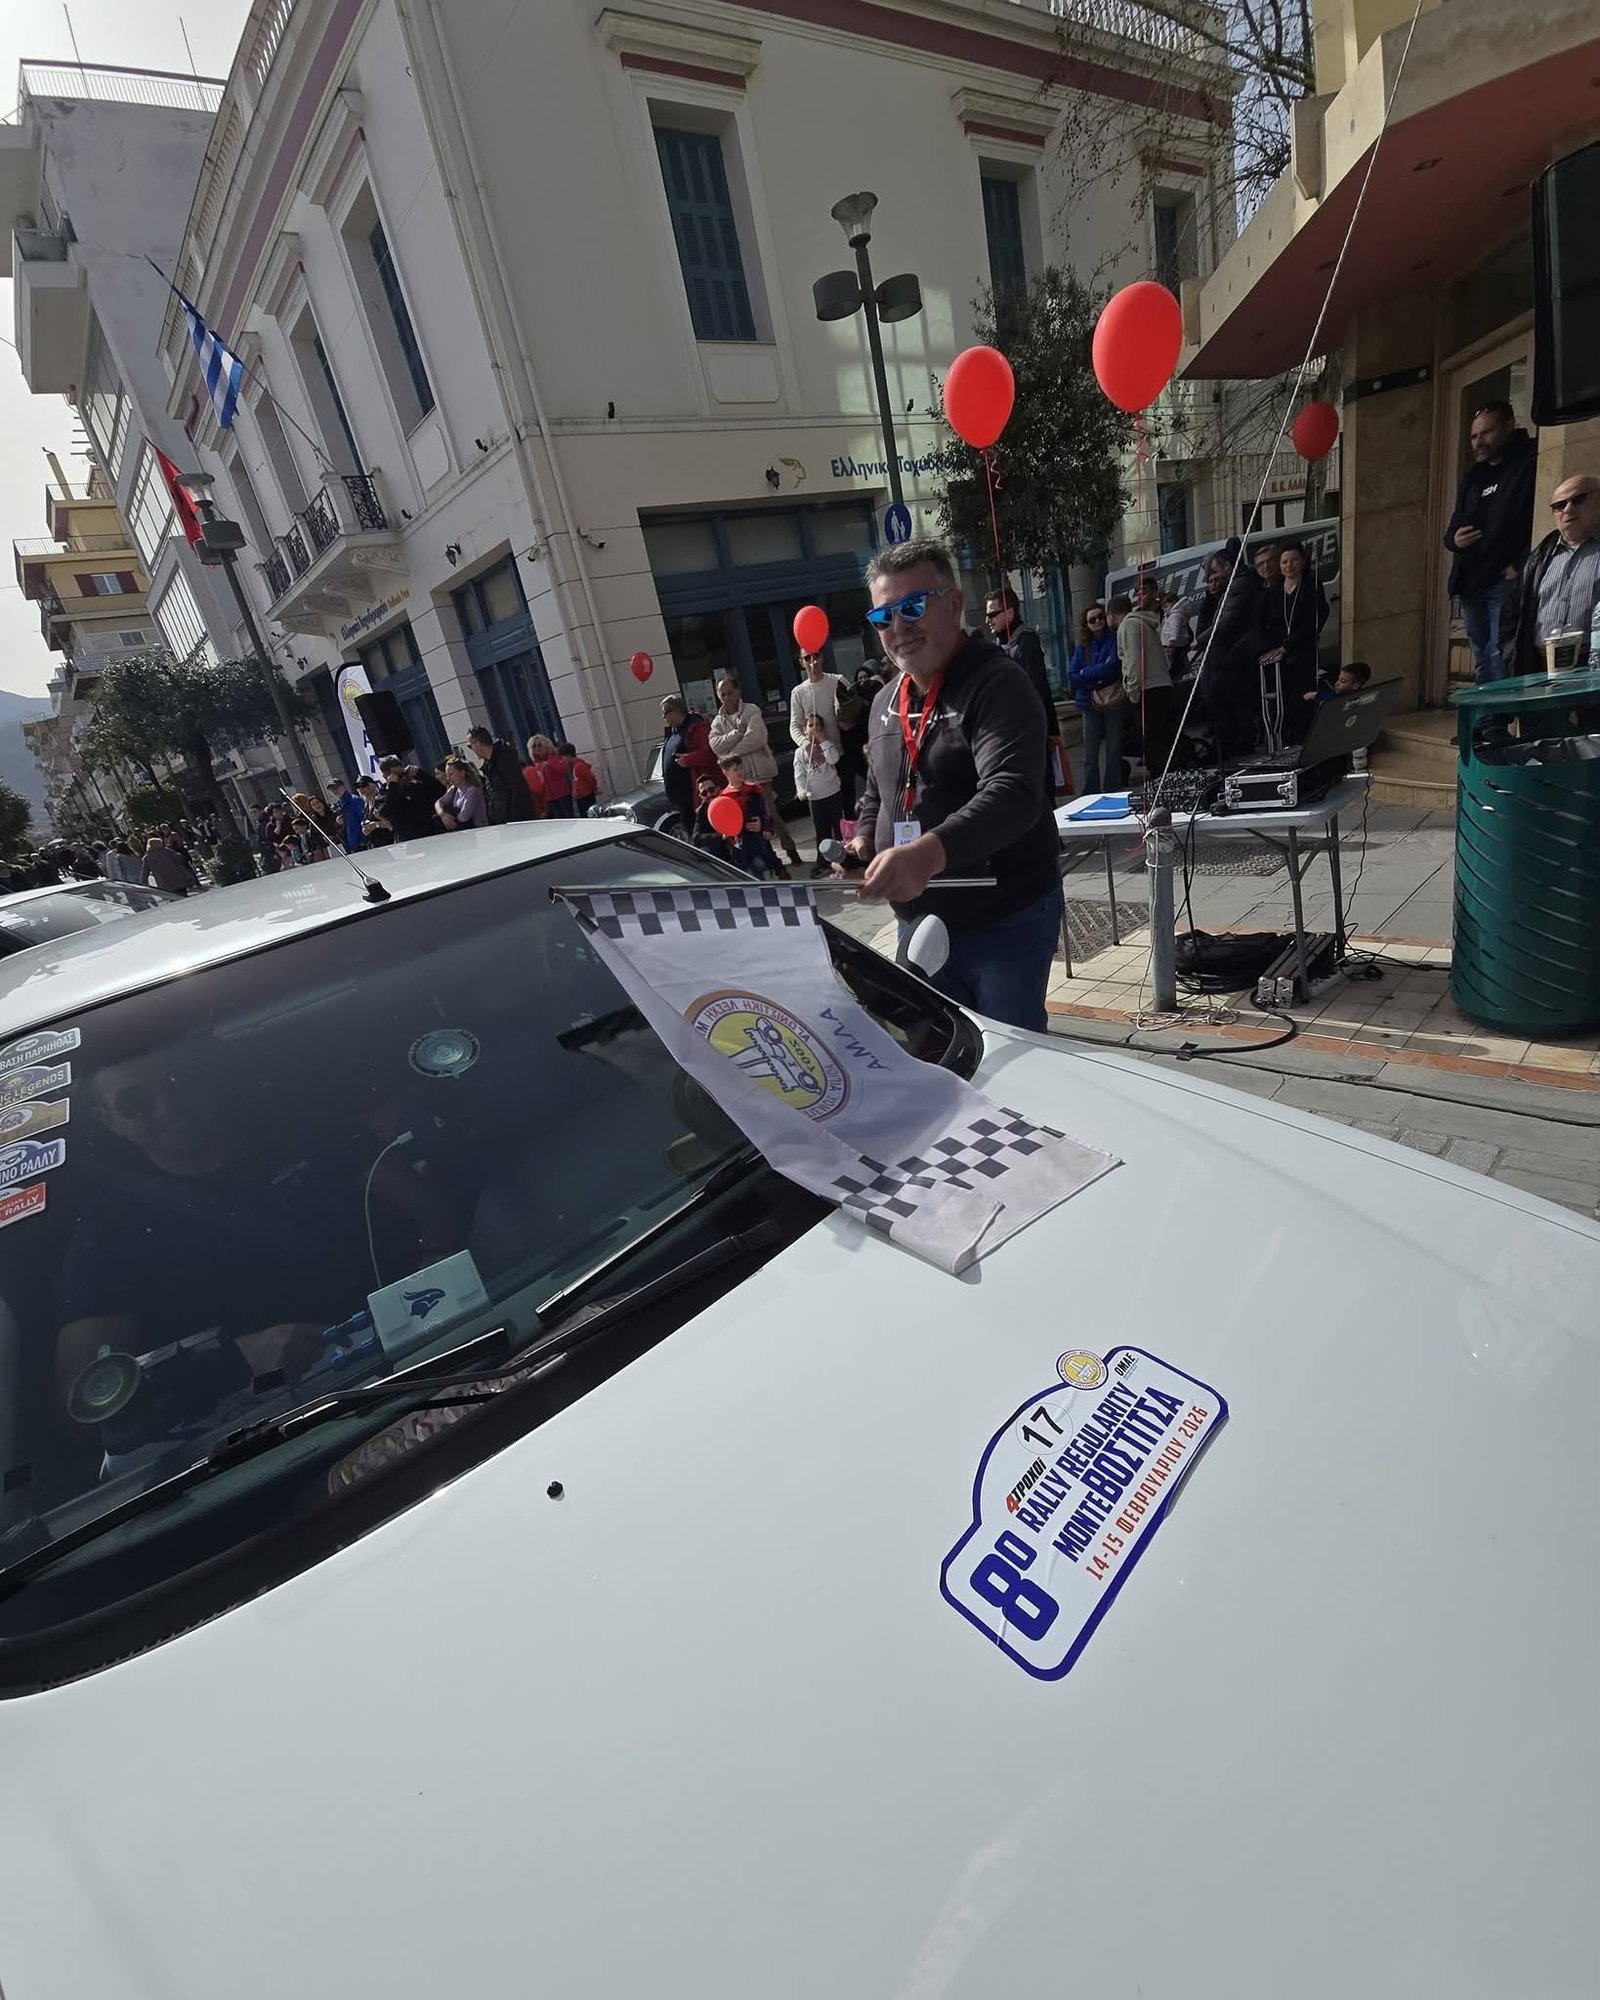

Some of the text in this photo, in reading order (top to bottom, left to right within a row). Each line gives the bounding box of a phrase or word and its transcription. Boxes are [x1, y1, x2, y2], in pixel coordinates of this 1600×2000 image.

[830, 455, 892, 480] Ελληνικ
[0, 1033, 74, 1071] ΒΑΣΗ ΠΑΡΝΗΘΑΣ
[15, 1070, 64, 1096] LEGENDS
[20, 1148, 57, 1175] ΡΑΛΛΥ
[5, 1194, 40, 1216] RALLY
[1023, 1405, 1064, 1449] 17
[1016, 1469, 1073, 1534] RALLY
[1056, 1380, 1138, 1478] REGULARITY
[1085, 1405, 1209, 1582] 14-15 ΦΕΒΡΟΥΑΡΙΟΥ 2026
